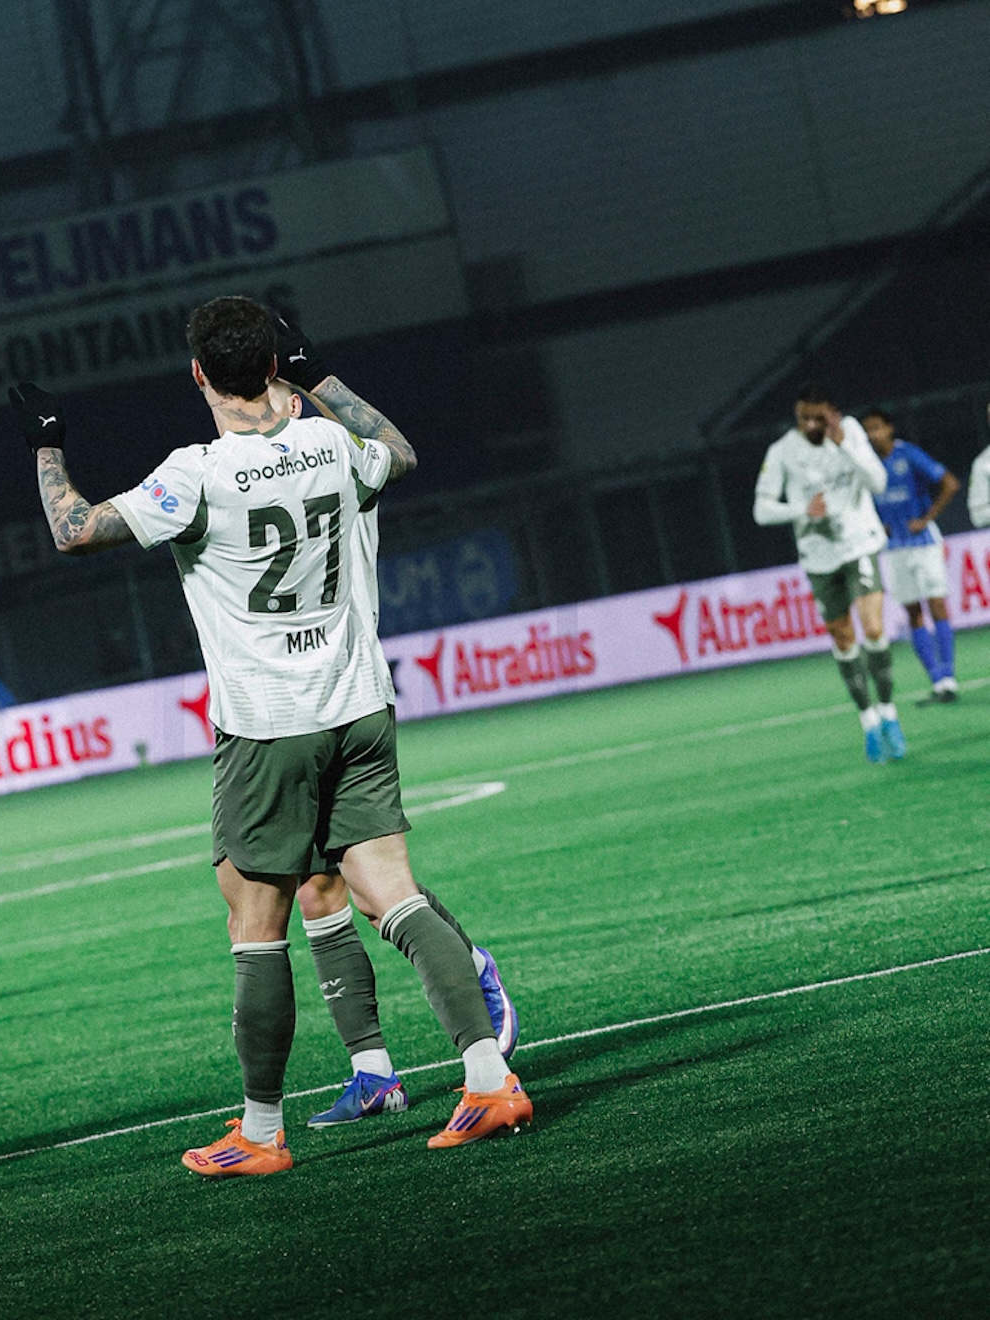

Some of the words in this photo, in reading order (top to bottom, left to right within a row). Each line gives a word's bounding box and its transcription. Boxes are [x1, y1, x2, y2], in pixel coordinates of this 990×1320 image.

[235, 448, 336, 492] goodhabitz
[248, 493, 340, 613] 27
[286, 626, 328, 654] MAN
[454, 624, 597, 697] Atradius
